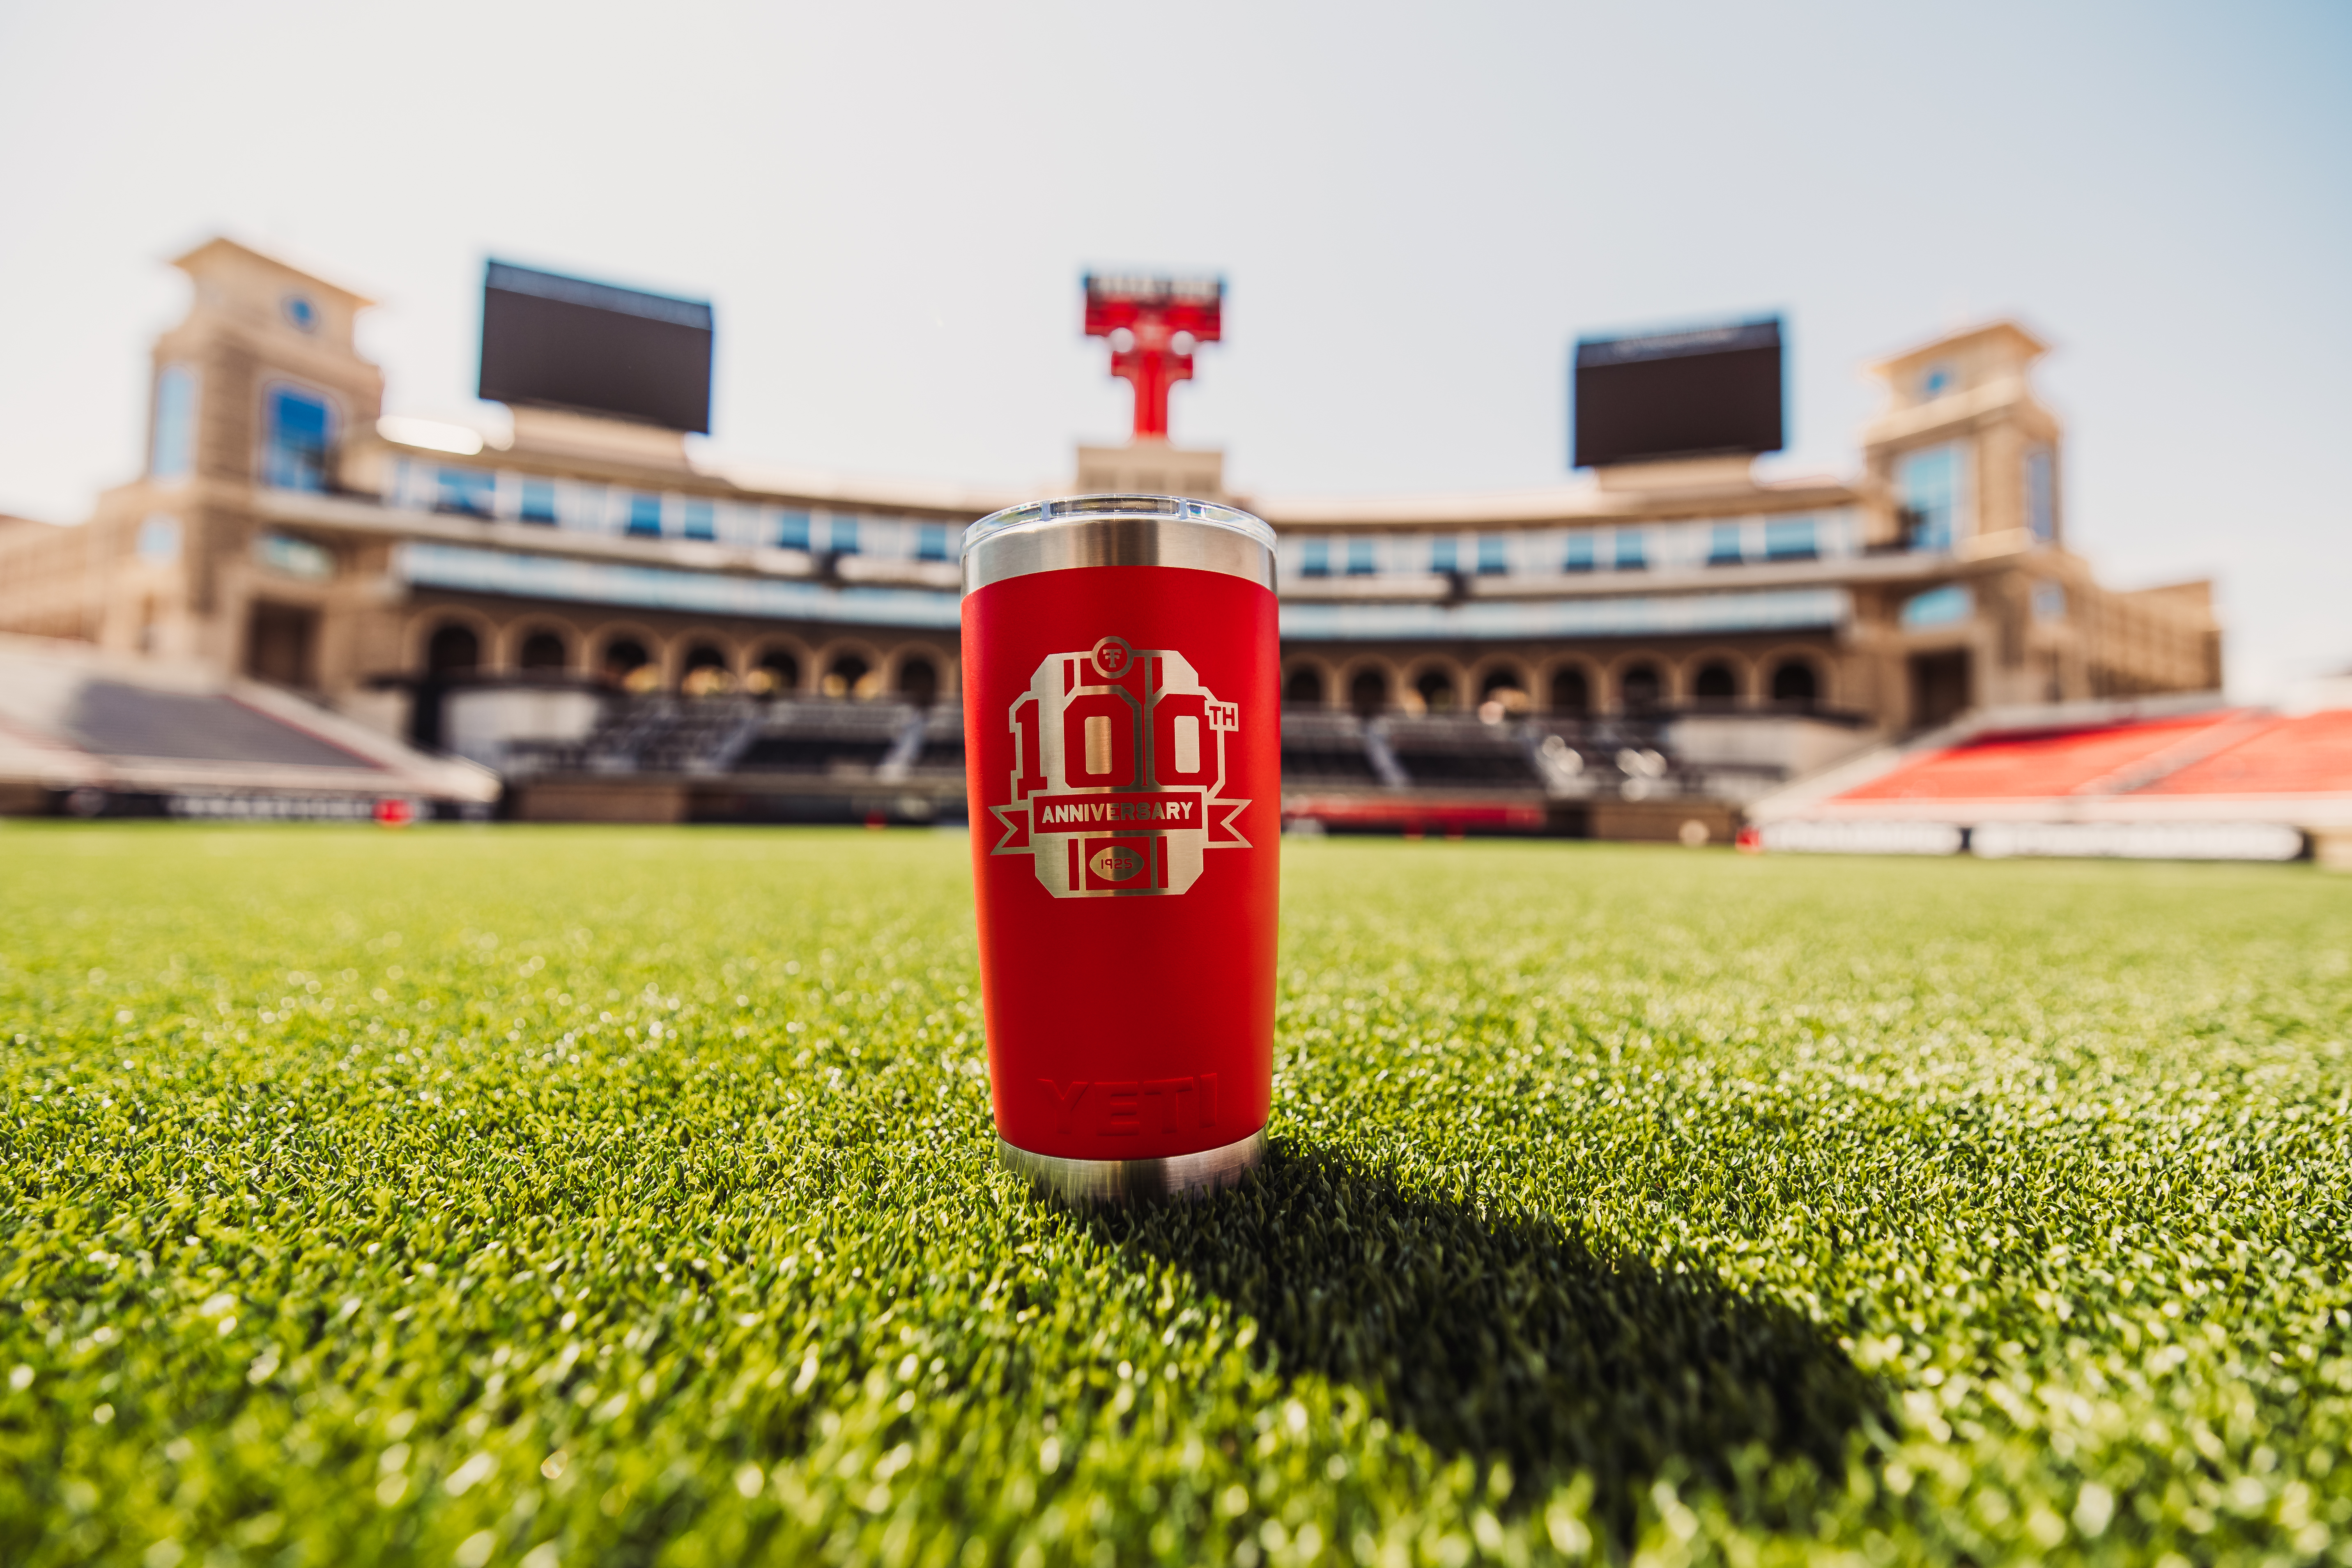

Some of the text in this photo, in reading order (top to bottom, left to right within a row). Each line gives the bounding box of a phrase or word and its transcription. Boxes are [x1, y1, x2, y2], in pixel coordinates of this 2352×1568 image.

[1042, 802, 1193, 823] ANNIVERSARY
[1101, 858, 1133, 869] 1925
[1037, 1072, 1218, 1136] YETI
